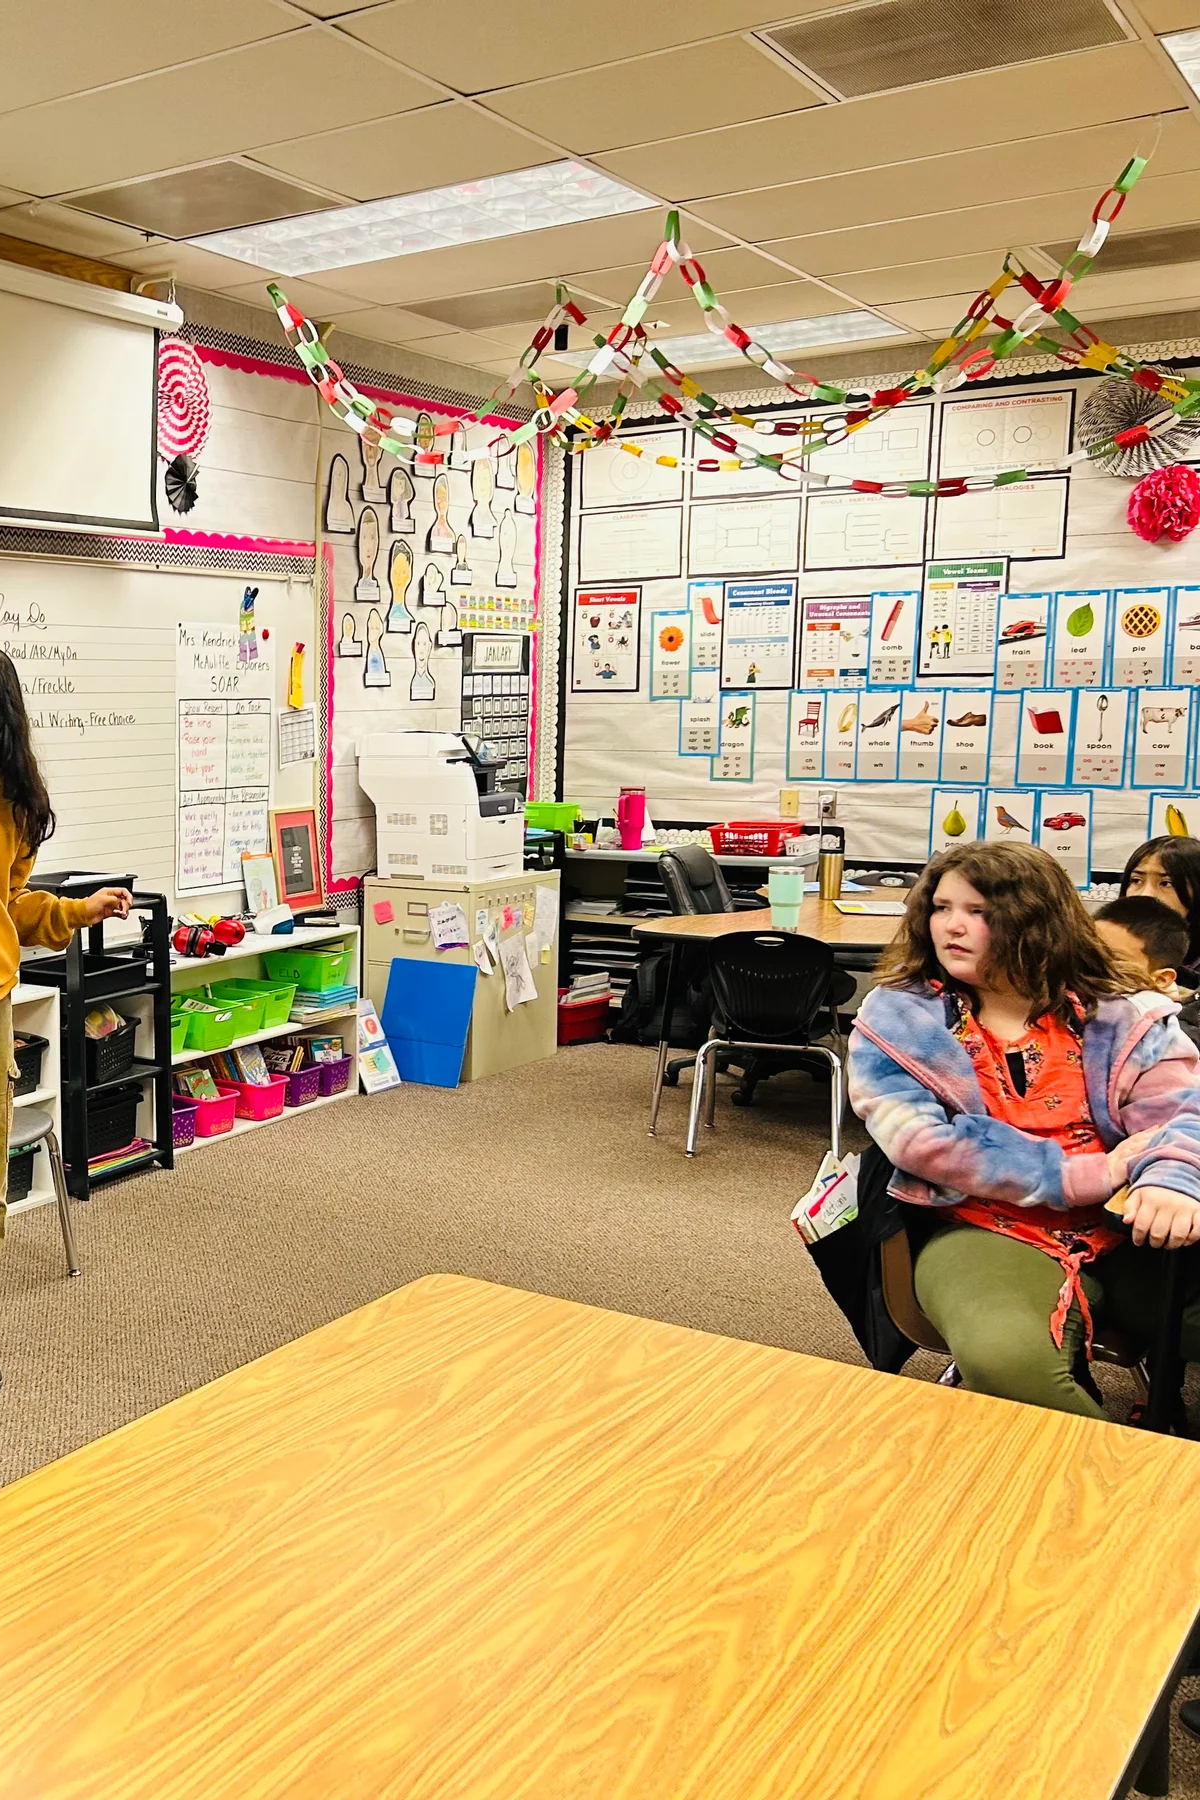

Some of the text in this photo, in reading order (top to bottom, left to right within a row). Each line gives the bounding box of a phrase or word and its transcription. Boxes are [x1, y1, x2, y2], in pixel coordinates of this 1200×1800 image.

[951, 402, 993, 411] COMPARING
[1011, 396, 1063, 406] CONTRASTING
[636, 436, 662, 445] CONTEXT
[994, 484, 1036, 492] ANALOGIES
[749, 503, 773, 511] EFFECT
[612, 513, 649, 521] CLASSIFYING
[732, 587, 788, 596] Consonant Blends
[589, 596, 605, 604] Short
[26, 602, 46, 624] Do
[819, 604, 848, 612] Digraphs
[178, 628, 195, 647] Mrs
[484, 645, 513, 662] JANUARY
[1132, 645, 1146, 653] pie
[193, 653, 230, 671] McAuliffe
[210, 676, 240, 693] SOAR
[248, 700, 262, 712] Task
[108, 712, 136, 726] Choice
[183, 717, 194, 728] Be
[838, 740, 853, 748] ring
[278, 968, 301, 979] ELD
